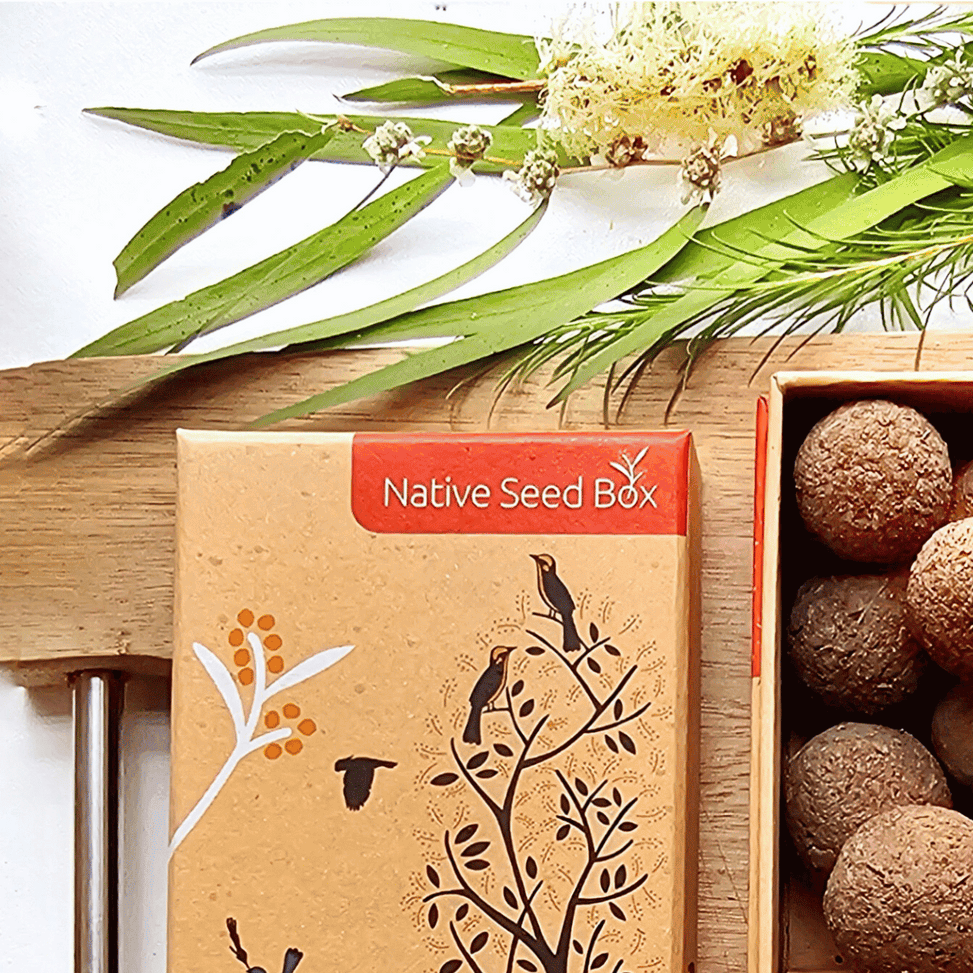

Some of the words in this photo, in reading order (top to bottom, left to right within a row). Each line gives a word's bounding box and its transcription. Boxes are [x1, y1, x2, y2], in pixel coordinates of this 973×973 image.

[383, 476, 491, 508] Native
[500, 476, 583, 509] Seed
[594, 477, 658, 509] Box
